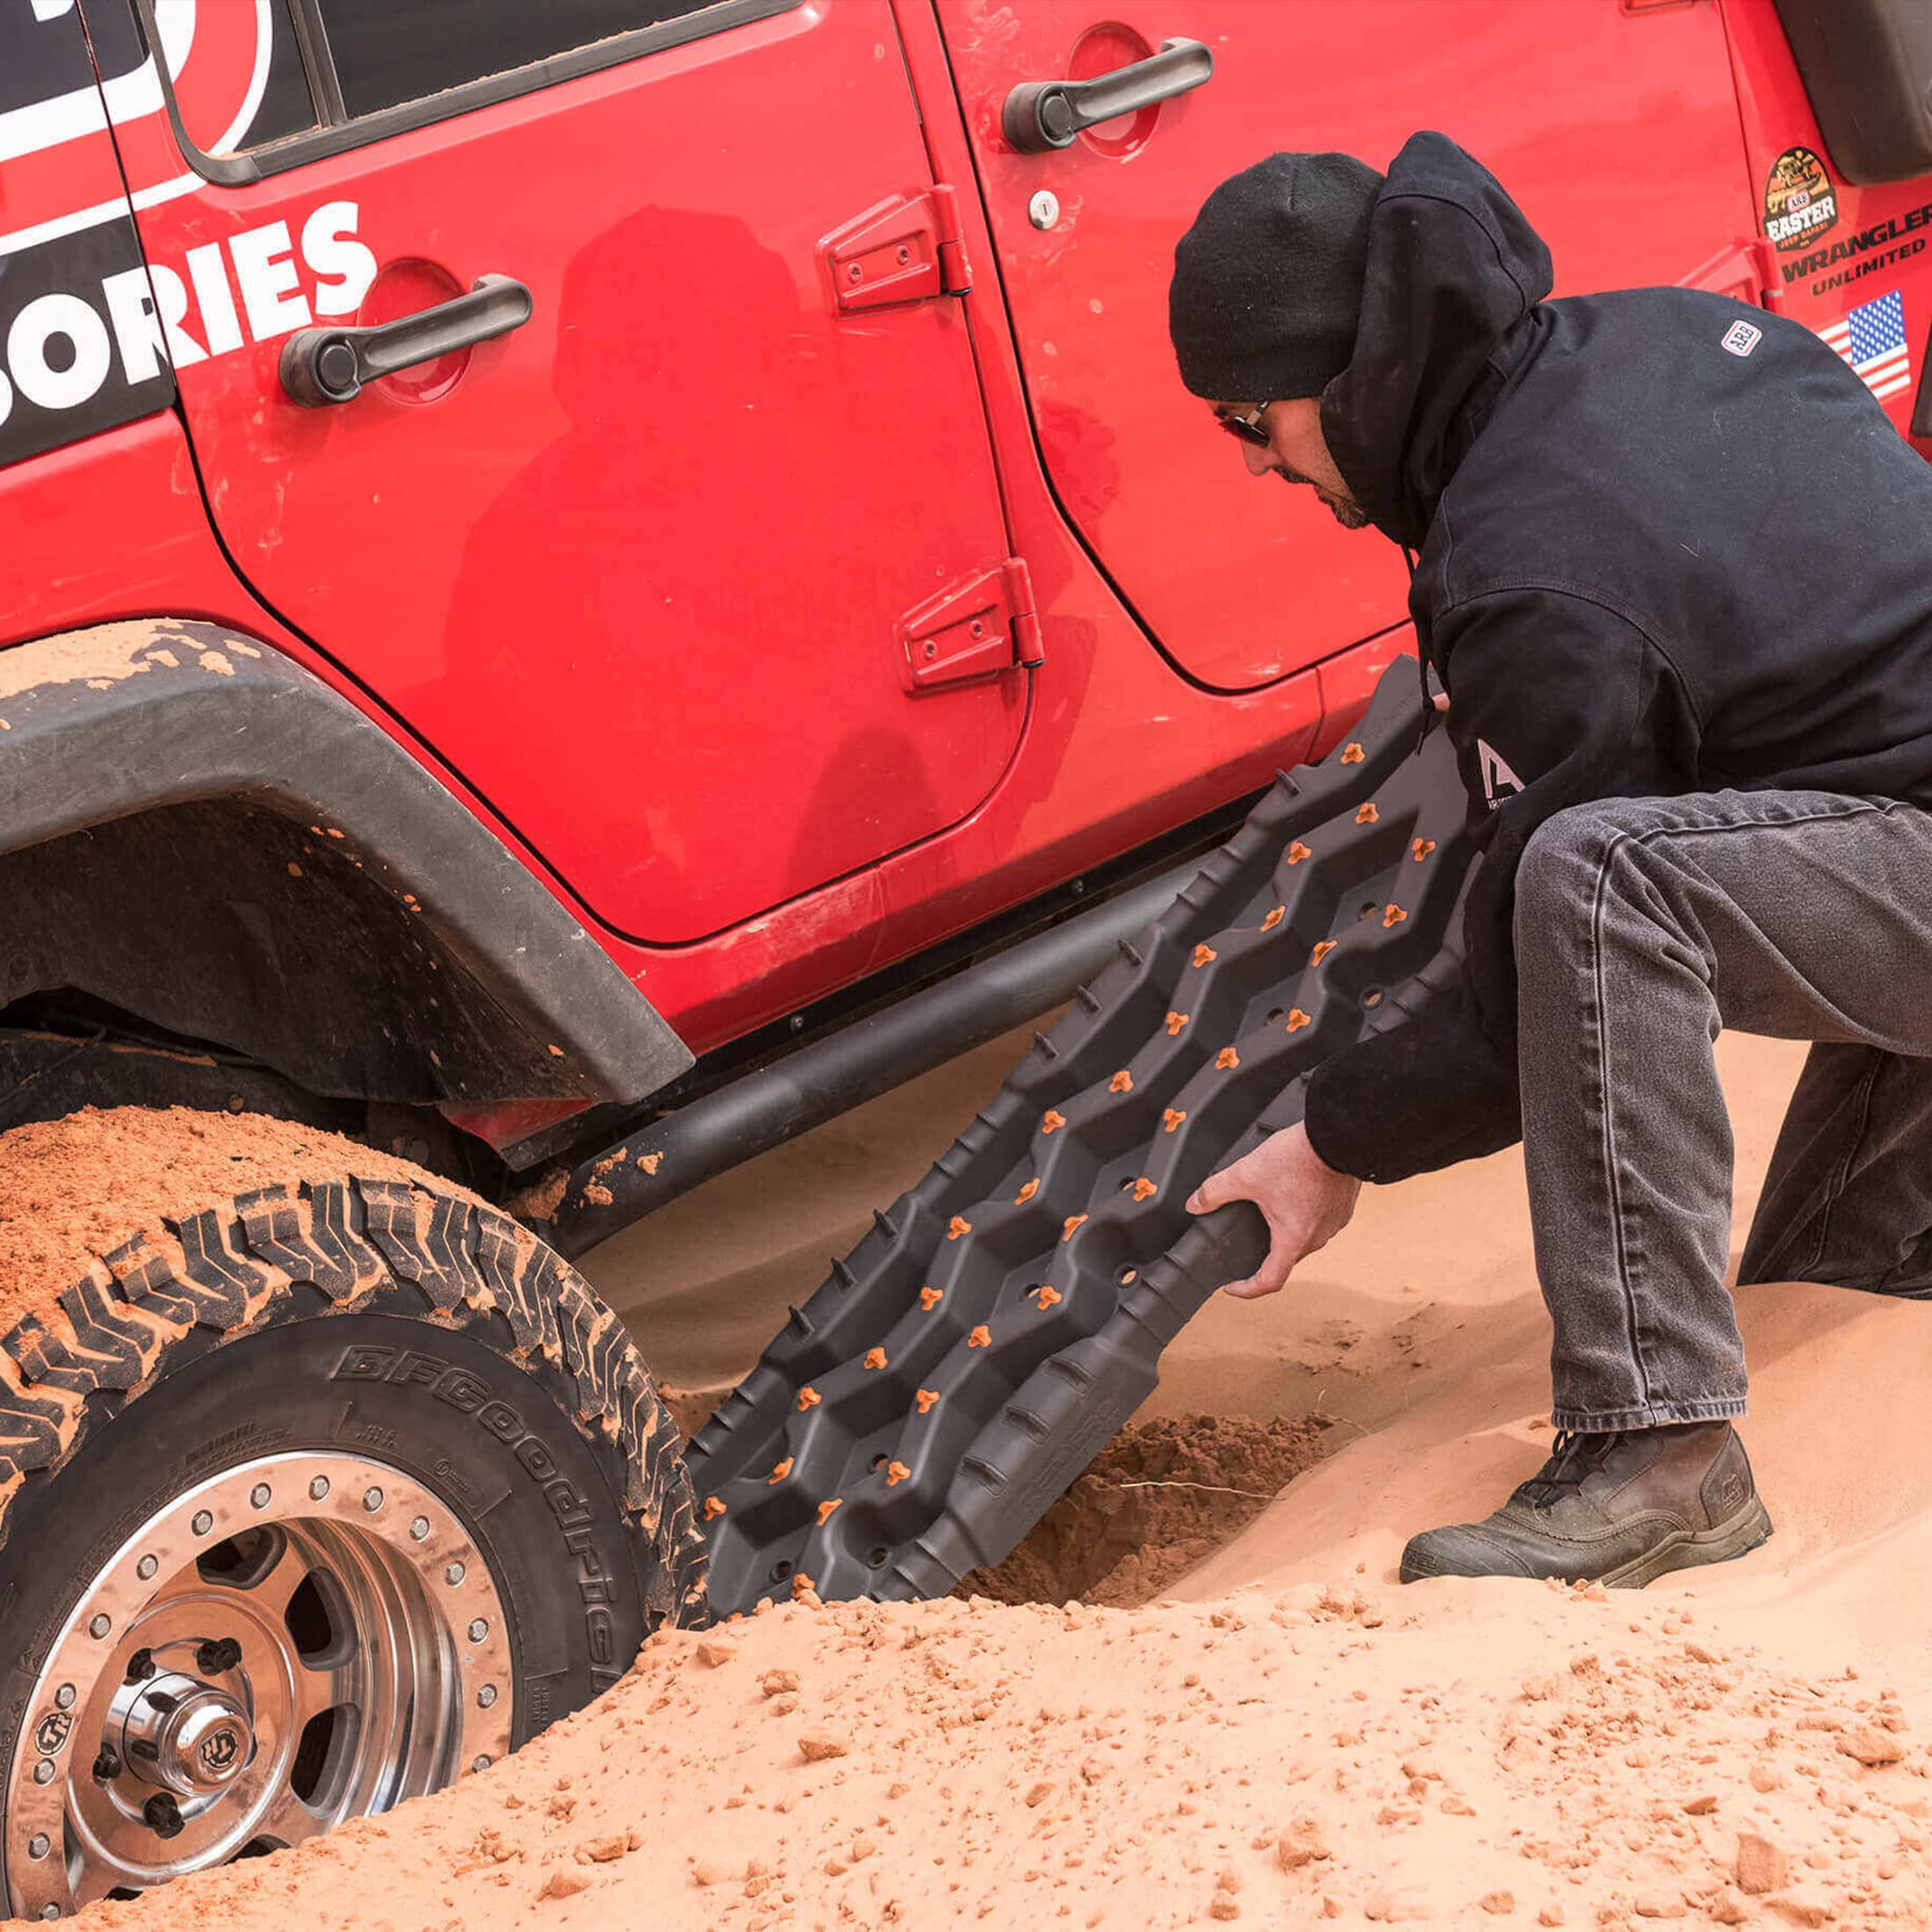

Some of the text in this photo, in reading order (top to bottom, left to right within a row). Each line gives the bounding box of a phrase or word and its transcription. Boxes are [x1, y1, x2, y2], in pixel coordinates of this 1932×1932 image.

[1766, 196, 1835, 242] EASTER
[1812, 238, 1926, 296] UNLIMITED
[0, 201, 377, 428] ORIES
[1730, 325, 1755, 350] ARB
